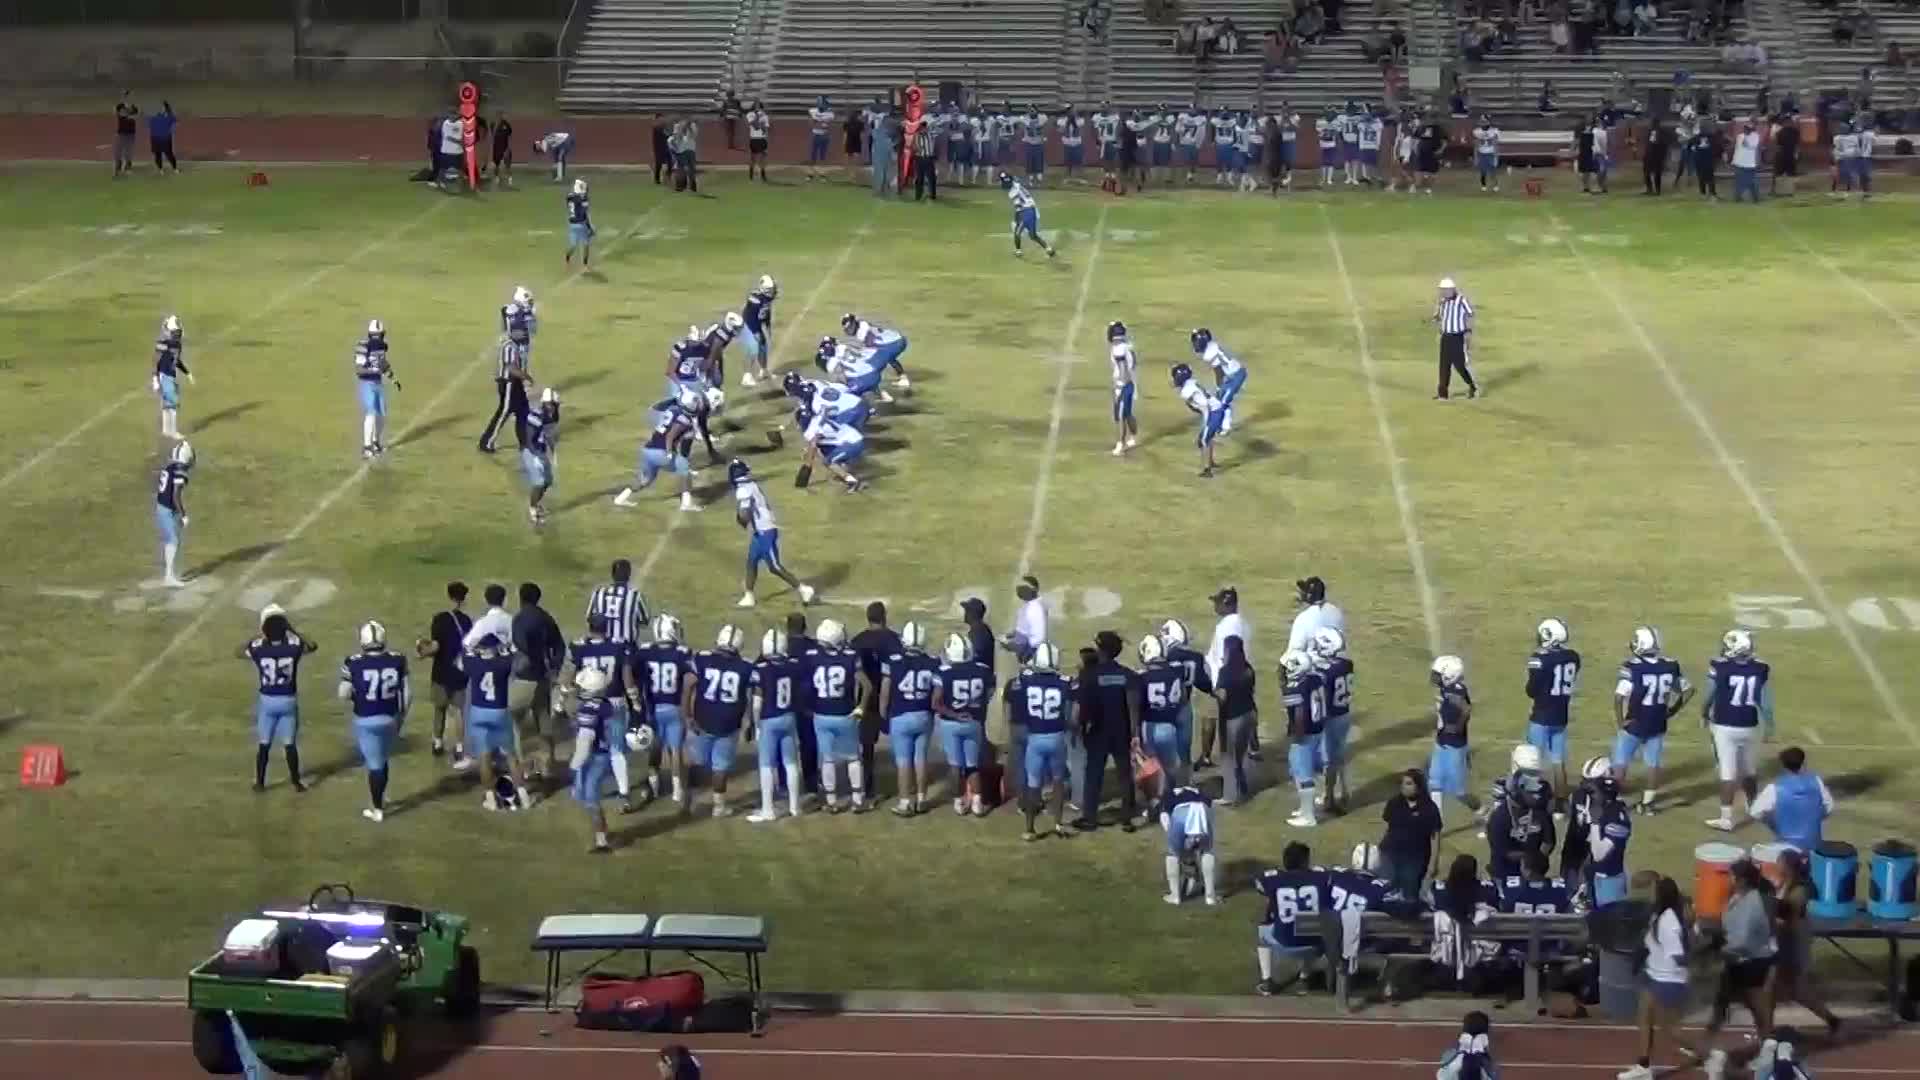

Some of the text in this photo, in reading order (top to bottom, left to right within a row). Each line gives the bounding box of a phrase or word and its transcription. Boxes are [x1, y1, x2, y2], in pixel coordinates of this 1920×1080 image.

[604, 594, 622, 619] H
[362, 668, 400, 702] 72
[478, 670, 497, 702] 4
[703, 667, 741, 703] 79
[776, 676, 792, 710] 8
[812, 664, 847, 698] 42
[1147, 681, 1182, 711] 54
[1549, 662, 1577, 697] 19
[1728, 674, 1758, 708] 71
[1025, 685, 1062, 720] 22
[1275, 886, 1321, 923] 63
